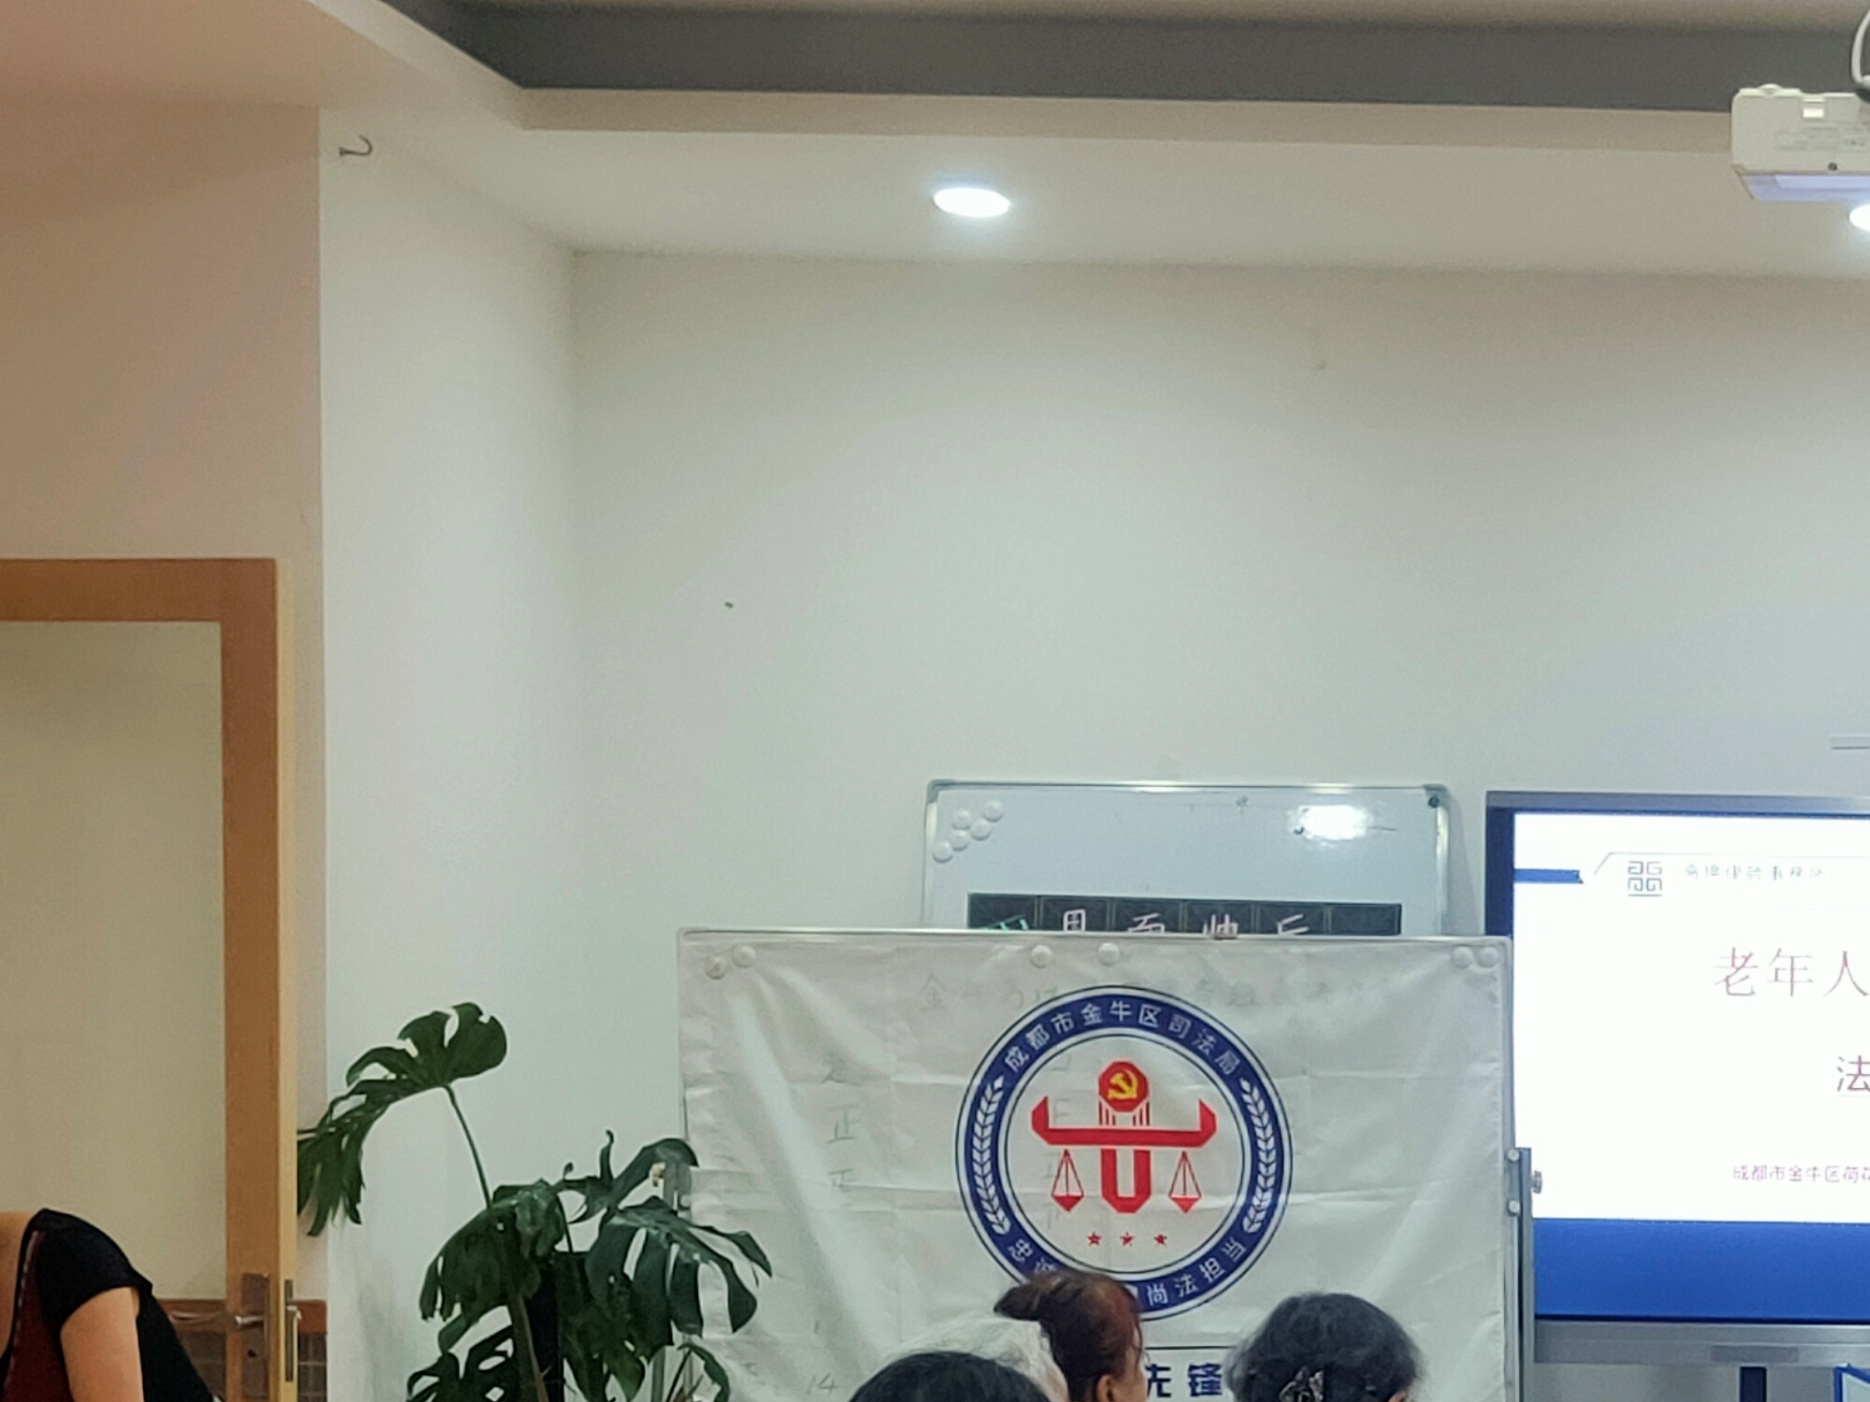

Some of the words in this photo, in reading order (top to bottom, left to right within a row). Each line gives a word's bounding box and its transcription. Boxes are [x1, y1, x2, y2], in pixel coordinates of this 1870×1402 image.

[1004, 1000, 1241, 1075] 成都市金牛区司法局
